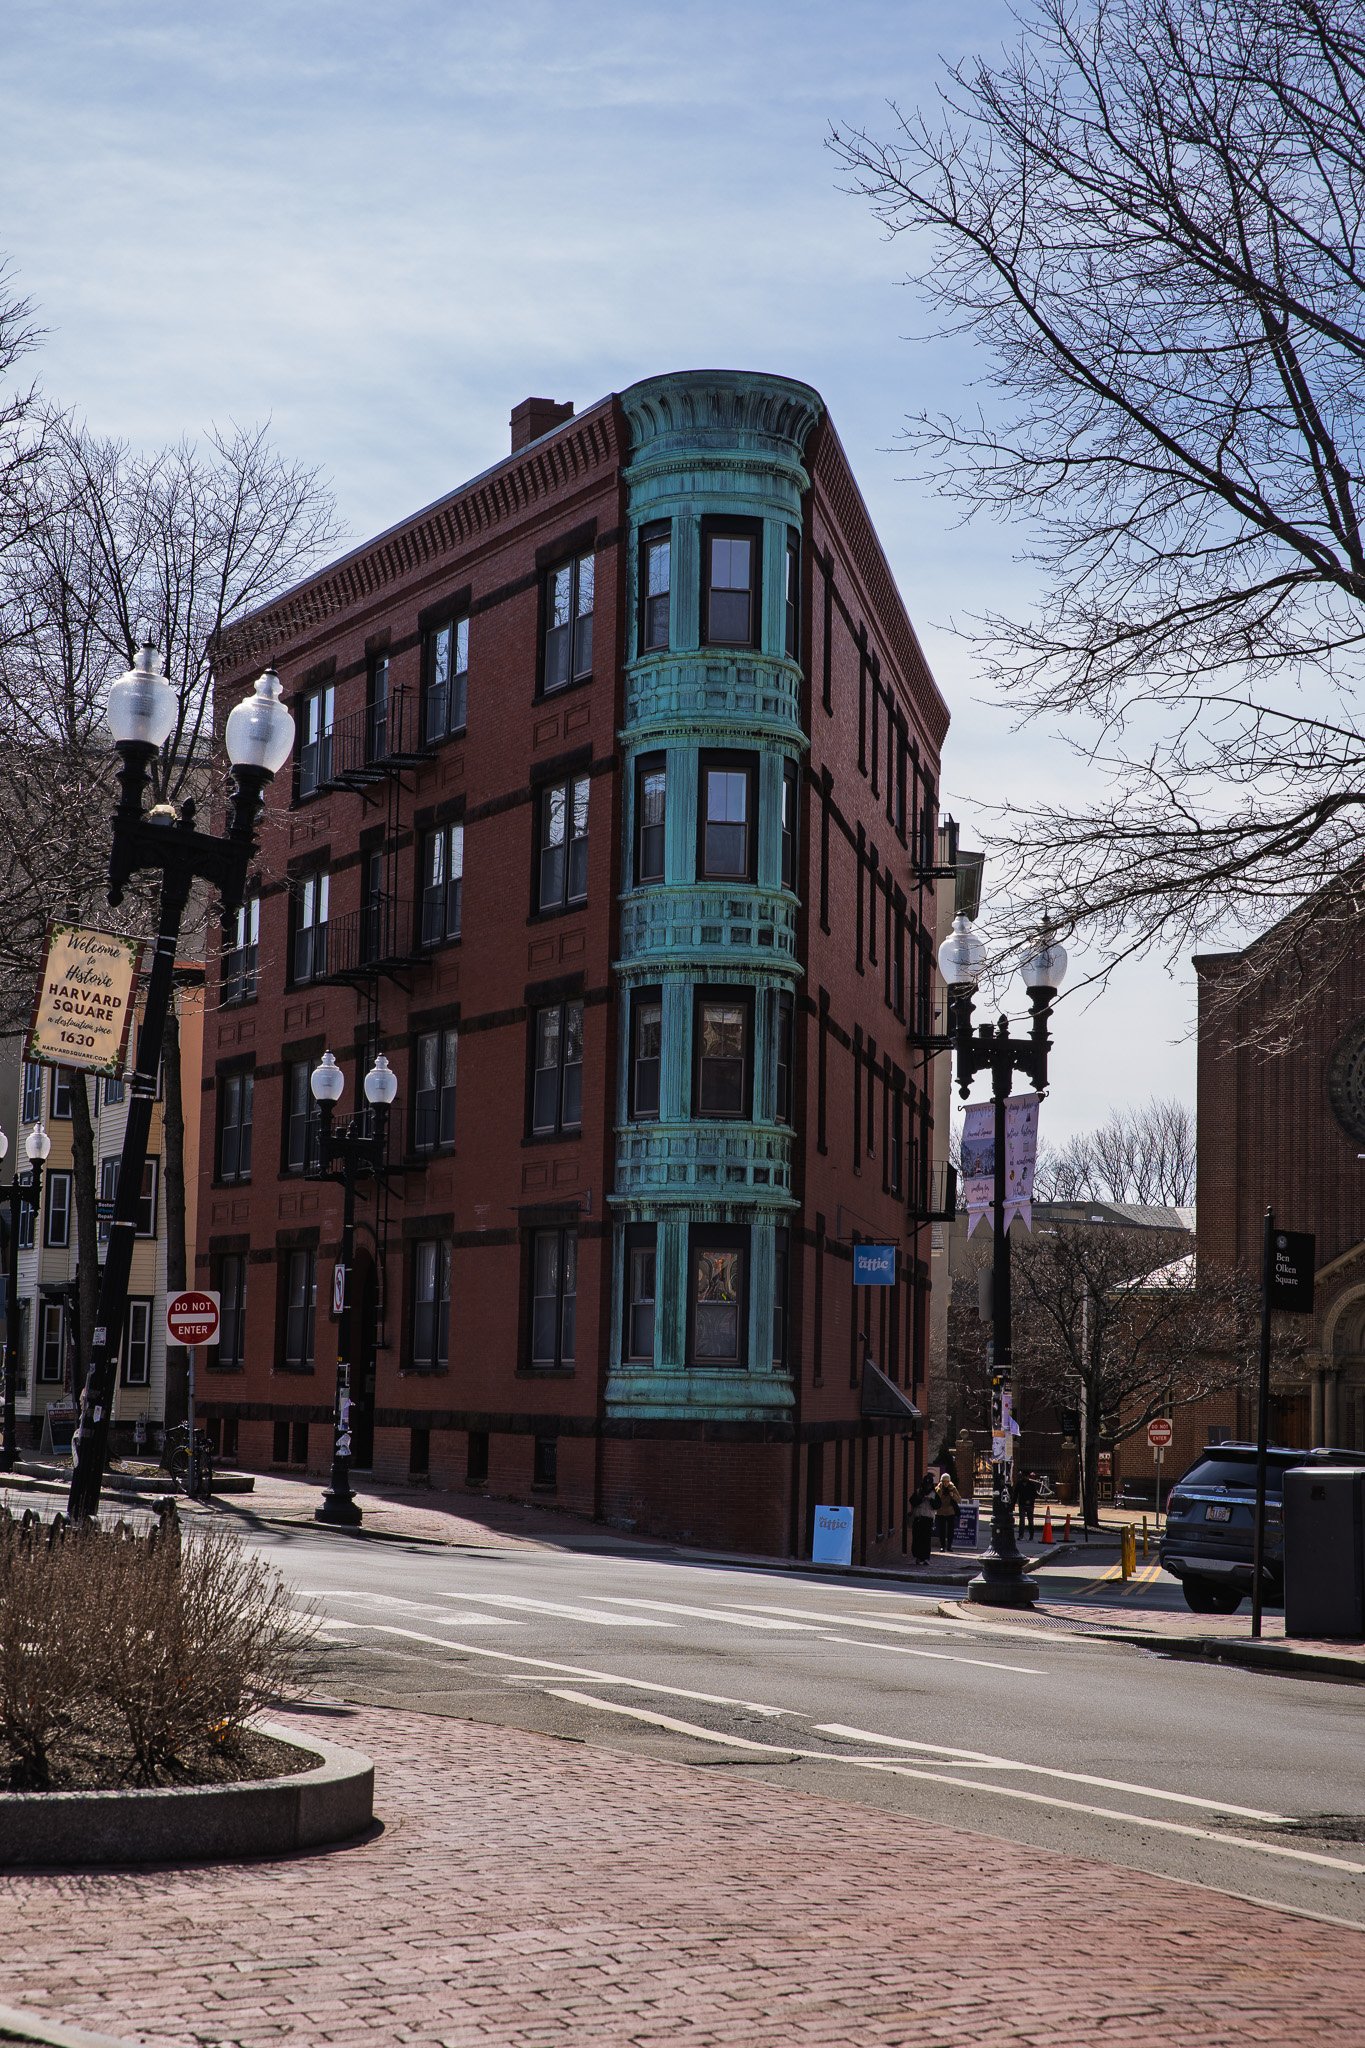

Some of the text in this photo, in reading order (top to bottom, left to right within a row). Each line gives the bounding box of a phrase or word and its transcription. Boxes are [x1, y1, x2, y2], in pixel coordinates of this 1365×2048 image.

[67, 934, 121, 958] Welcome
[86, 955, 96, 965] to
[65, 964, 113, 988] Historic
[49, 984, 122, 1008] HARVARD
[52, 999, 114, 1022] SQUARE
[54, 1016, 94, 1031] destination
[94, 1025, 112, 1035] since
[60, 1031, 95, 1047] 1630
[42, 1044, 108, 1063] HARVARDSQUARE.COM
[1276, 1253, 1290, 1262] Ben
[858, 1258, 889, 1271] attic
[1276, 1263, 1297, 1274] Olken
[1275, 1274, 1298, 1285] Square
[175, 1302, 211, 1311] DO NOT
[178, 1326, 208, 1335] ENTER
[819, 1518, 848, 1531] attic
